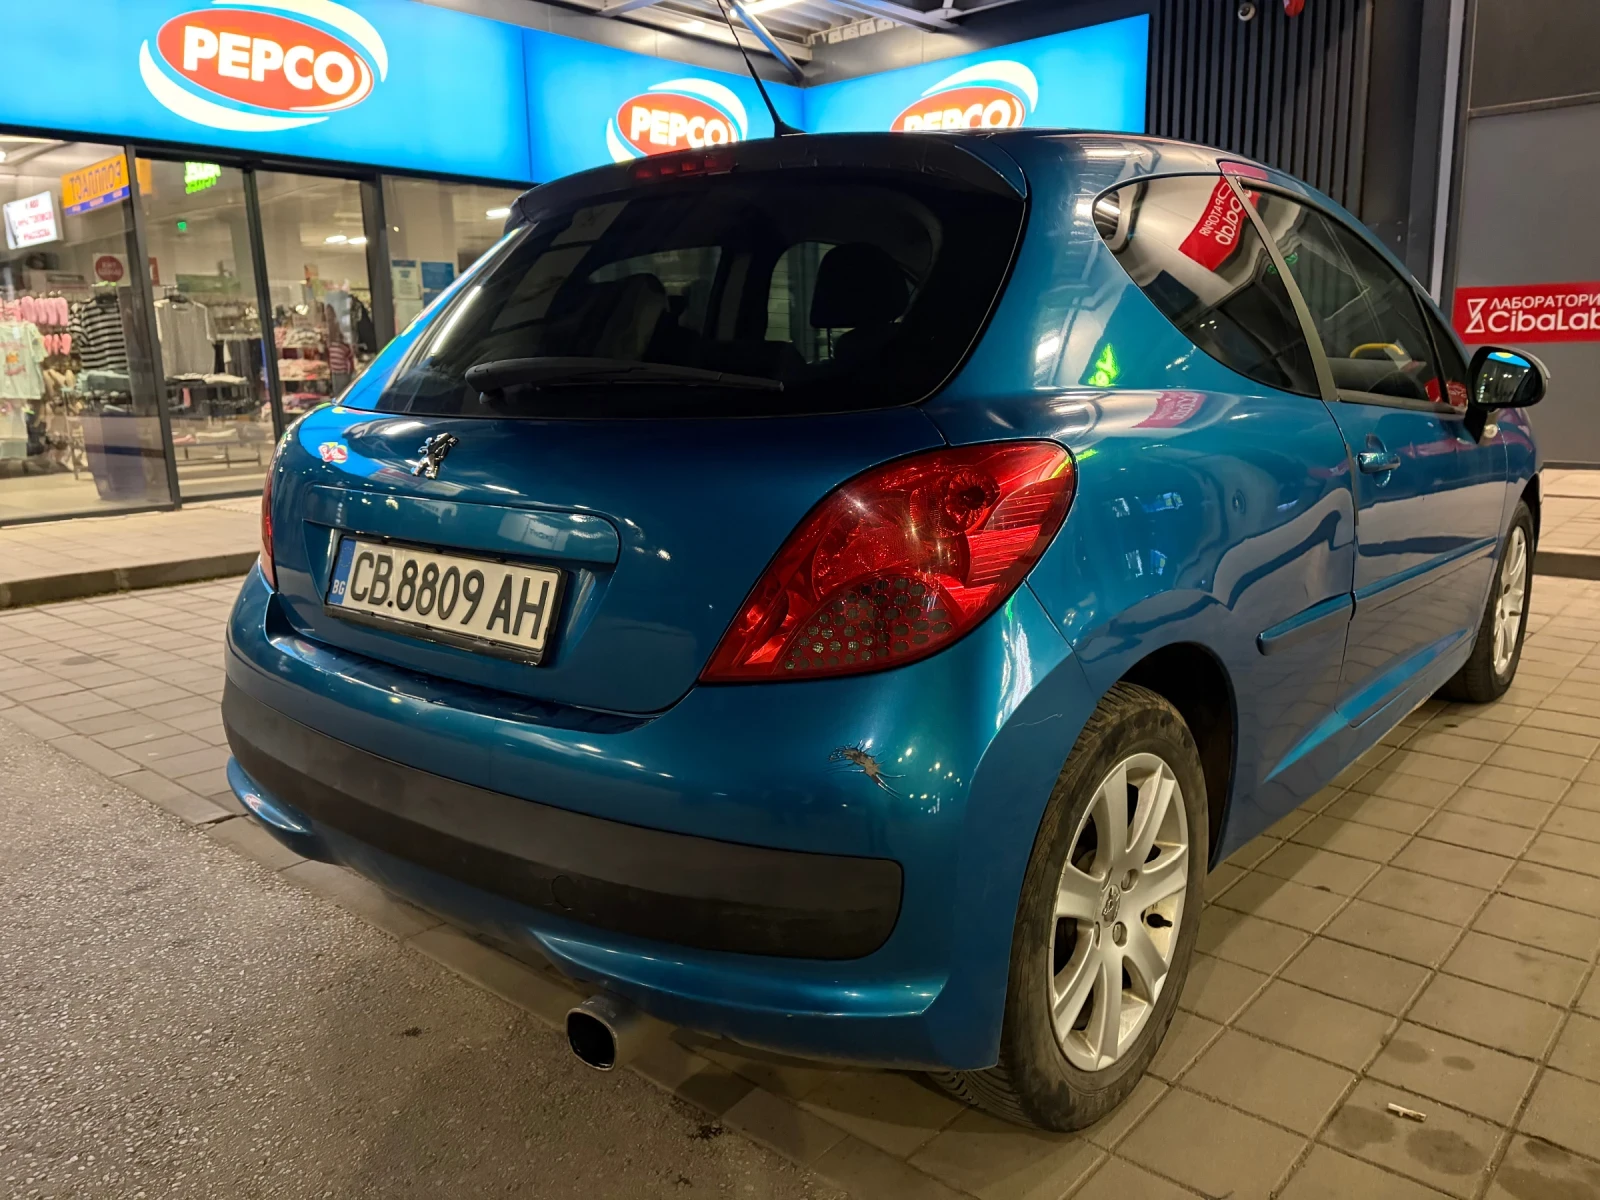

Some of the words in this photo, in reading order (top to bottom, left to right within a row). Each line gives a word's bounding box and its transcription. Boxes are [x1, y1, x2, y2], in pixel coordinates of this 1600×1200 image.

[182, 25, 356, 96] PEPCO
[630, 105, 729, 149] PEPCO
[1487, 308, 1600, 333] CibaLab
[332, 579, 346, 595] BG
[486, 573, 550, 640] AH
